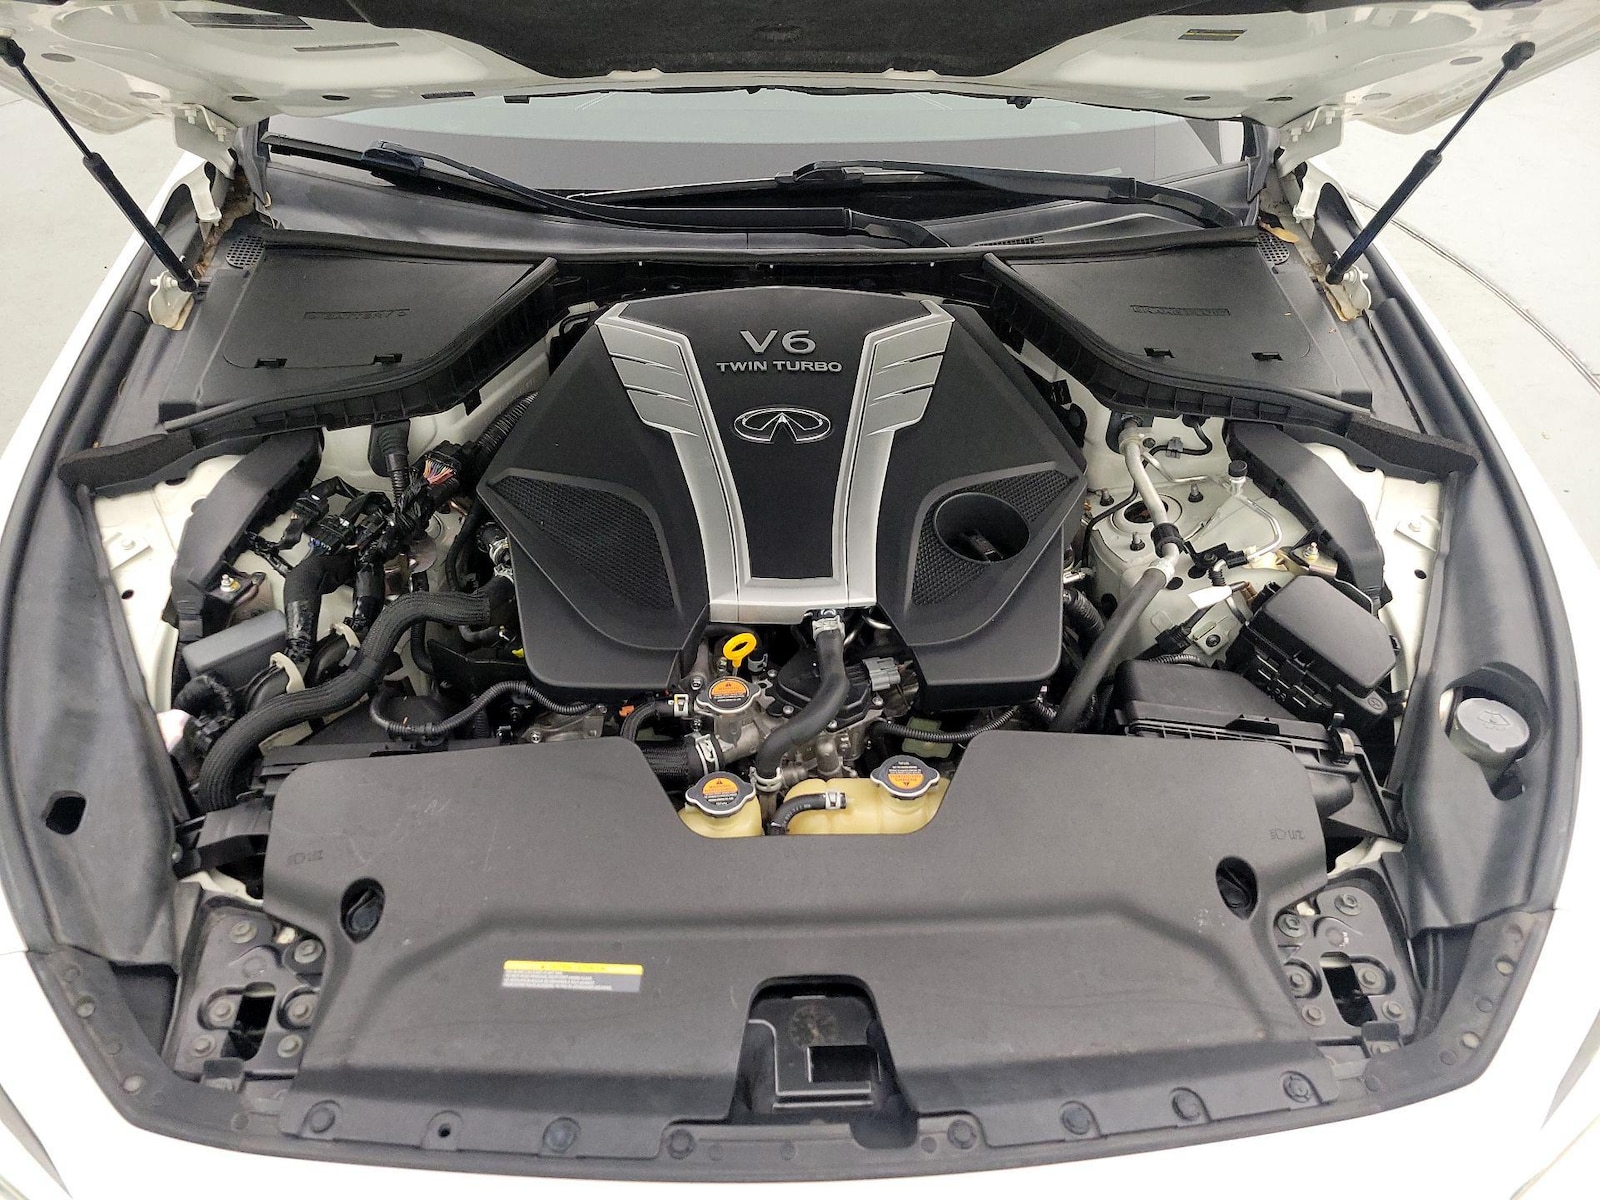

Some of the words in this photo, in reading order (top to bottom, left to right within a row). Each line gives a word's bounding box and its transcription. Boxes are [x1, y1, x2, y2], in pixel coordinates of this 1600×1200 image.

[740, 330, 816, 354] V6
[716, 361, 768, 372] TWIN
[773, 361, 842, 372] TURBO
